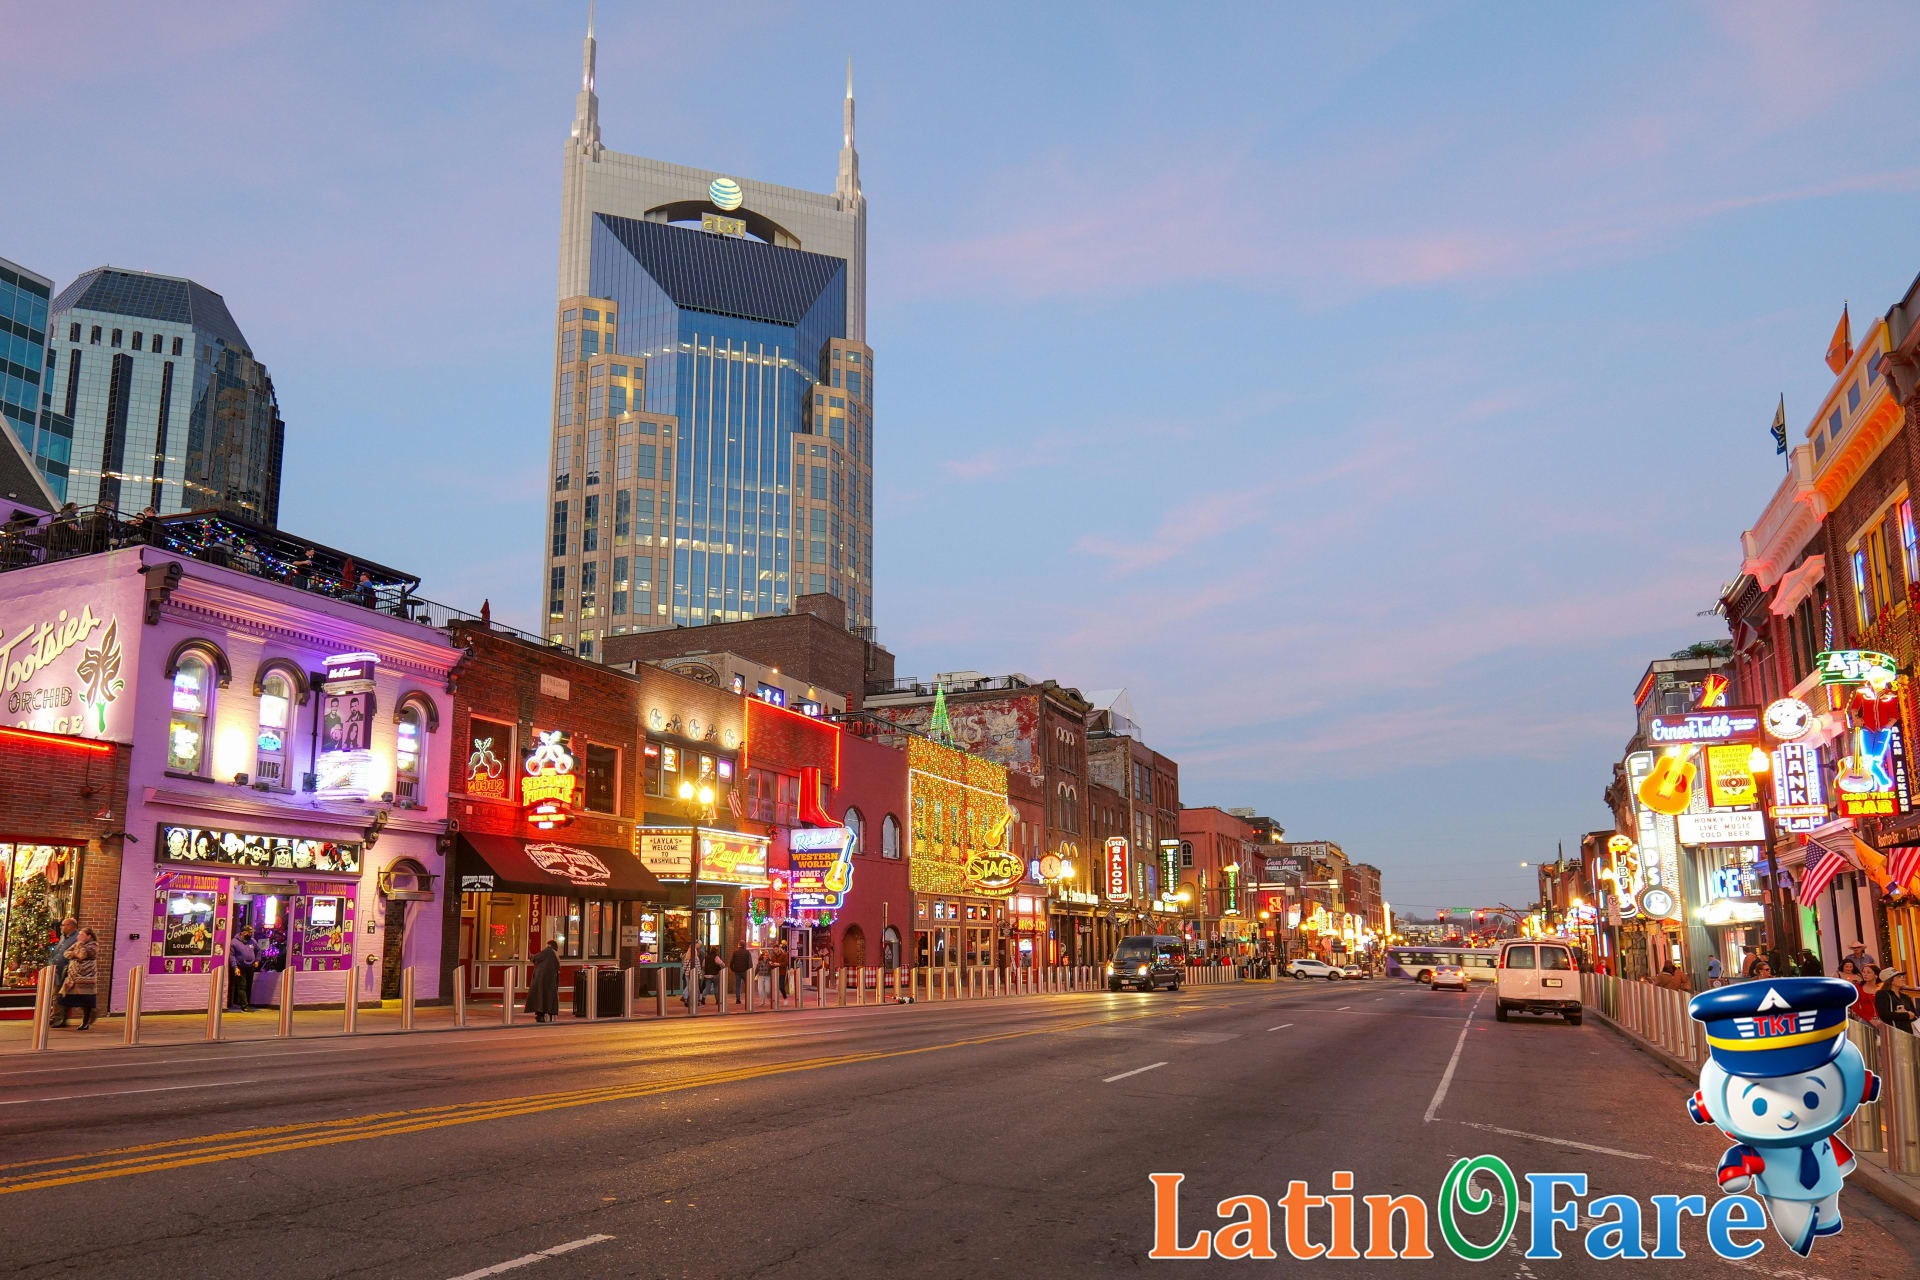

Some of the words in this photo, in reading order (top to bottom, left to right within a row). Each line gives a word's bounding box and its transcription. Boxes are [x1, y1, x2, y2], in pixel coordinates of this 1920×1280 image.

[703, 216, 745, 237] at&t
[0, 604, 102, 699] Tootsies
[8, 687, 73, 714] ORCHID
[1651, 718, 1698, 741] Ernest
[1684, 715, 1731, 740] Tubb
[1891, 726, 1902, 756] ALAN
[521, 774, 576, 794] SECOND
[1785, 744, 1808, 804] HANK
[523, 786, 573, 806] FIDDLE
[1841, 793, 1868, 801] GOOD
[1869, 791, 1896, 801] TIME
[1896, 760, 1909, 813] JACKSON
[1847, 800, 1894, 815] BAR
[1694, 816, 1724, 824] HONKY
[1724, 822, 1751, 830] MUSIC
[1791, 818, 1810, 828] JR
[792, 853, 839, 862] WESTERN
[798, 861, 832, 869] WORLD
[792, 870, 821, 878] HOME
[965, 855, 1023, 881] STAGE
[1111, 846, 1123, 894] SALOON
[168, 874, 192, 888] WORLD
[193, 875, 219, 890] FAMOUS
